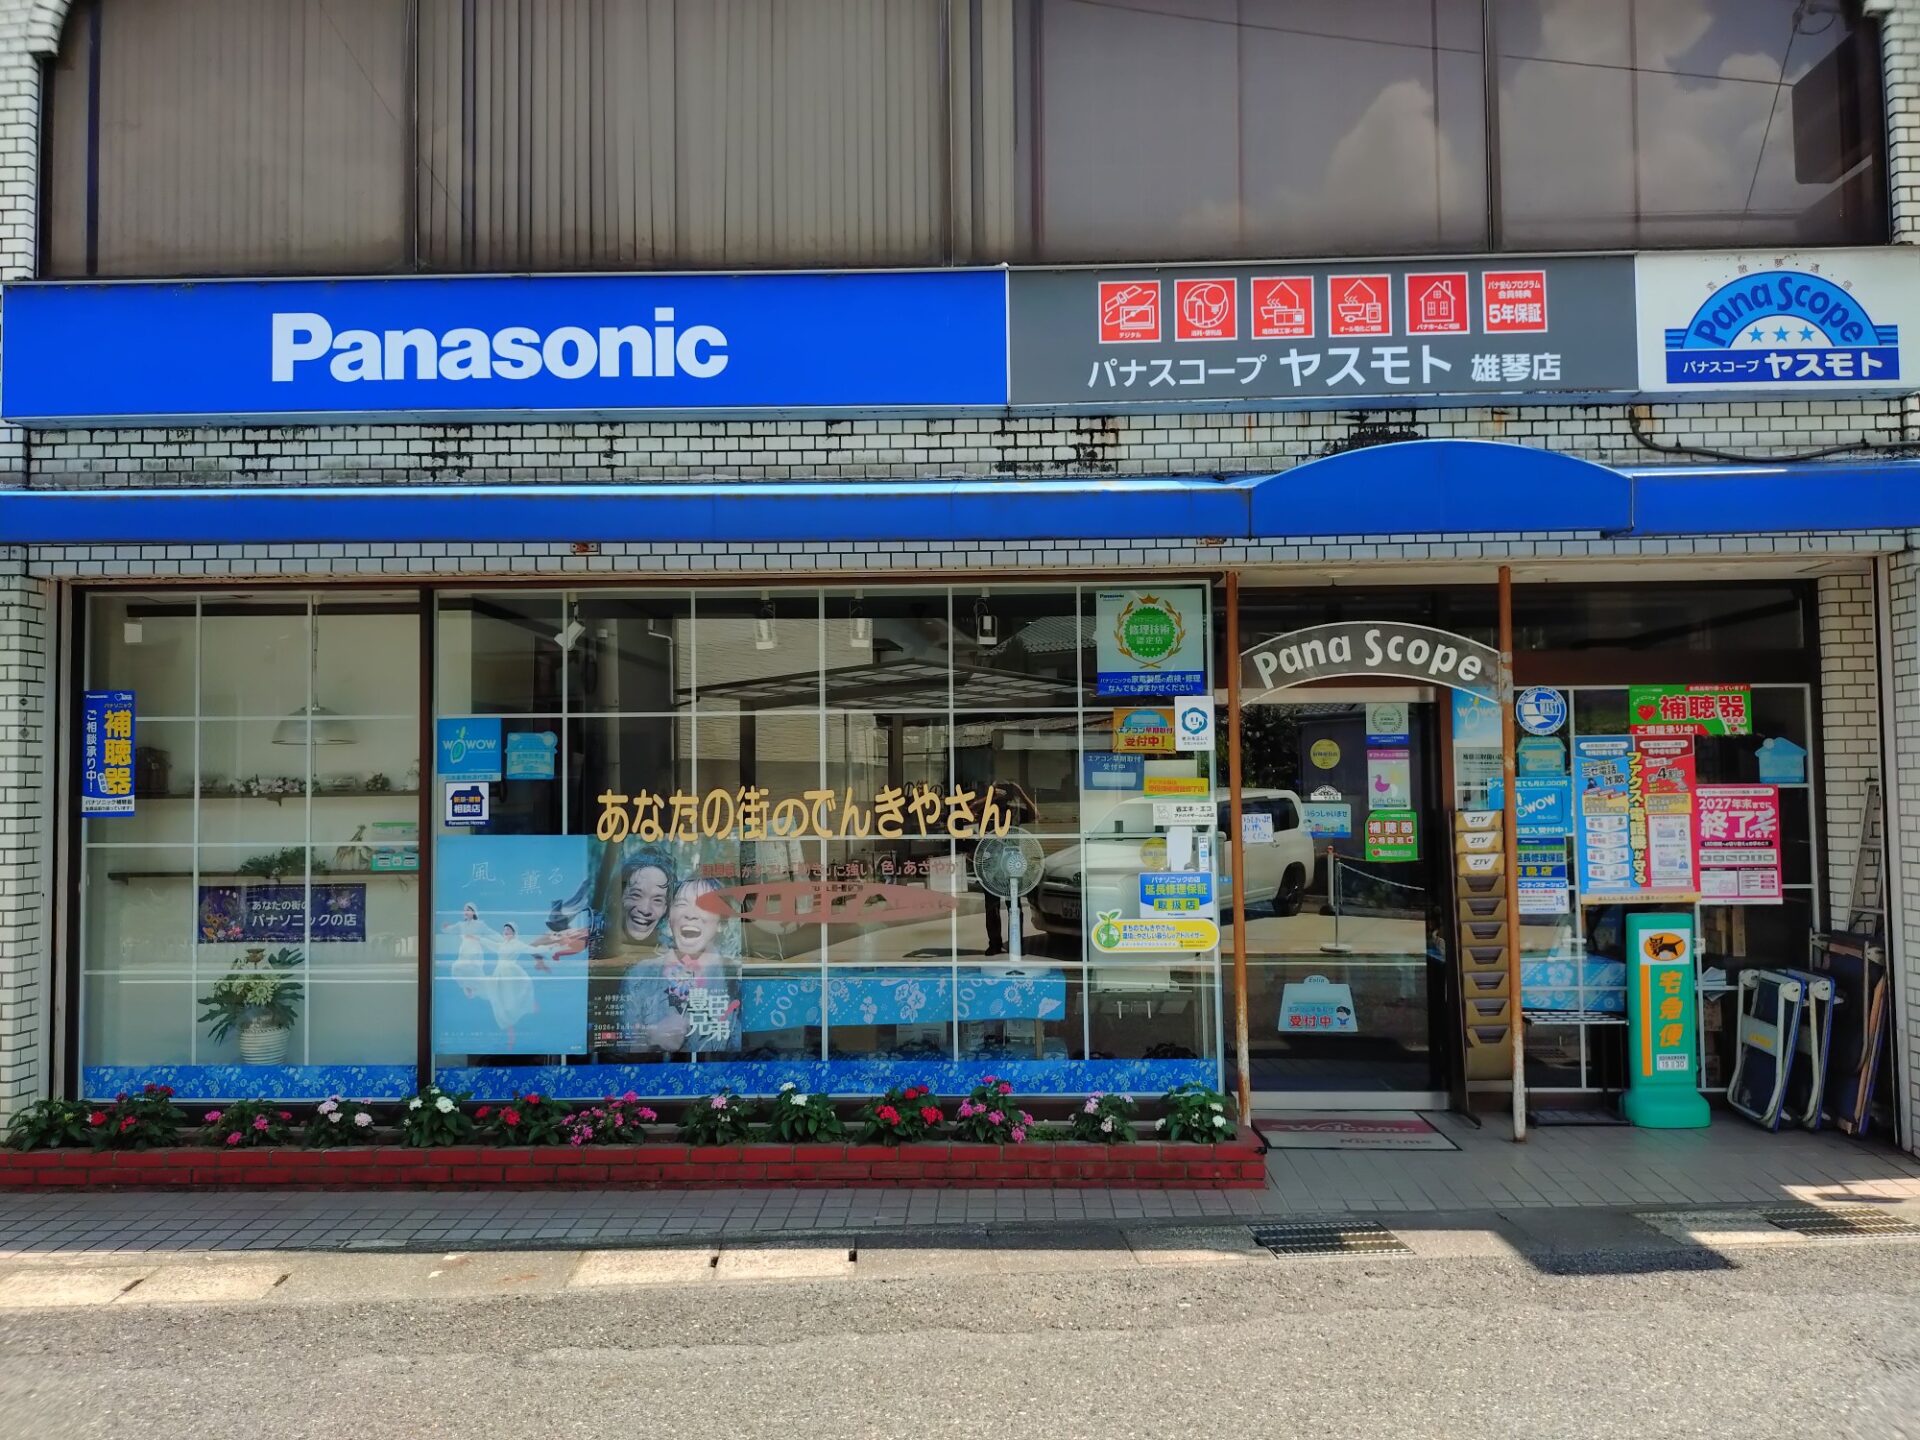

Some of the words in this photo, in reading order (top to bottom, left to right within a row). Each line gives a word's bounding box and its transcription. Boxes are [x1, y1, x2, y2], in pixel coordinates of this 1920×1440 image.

[1488, 302, 1542, 324] 5年保証
[1693, 282, 1773, 348] Pana
[1776, 276, 1864, 344] Scope
[272, 306, 729, 383] Panasonic
[1119, 331, 1142, 339] デジタル
[1087, 353, 1268, 390] パナスコープ
[1279, 345, 1453, 387] ヤスモト
[1470, 352, 1561, 383] 雄琴店
[1683, 359, 1760, 374] パナスコープ
[1764, 351, 1884, 379] ヤスモト
[1252, 634, 1351, 690] Pana
[1363, 628, 1482, 682] Scope
[1659, 694, 1745, 721] 補聴器
[104, 709, 132, 795] 補聴器
[596, 783, 1012, 844] あなたの街のでんきやさん
[1470, 814, 1488, 823] ZTV
[1700, 809, 1756, 839] 終了
[1470, 835, 1488, 844] ZTV
[1472, 857, 1490, 866] ZTV
[1145, 884, 1208, 896] 延長修理保証
[252, 913, 357, 927] パナソニックの店
